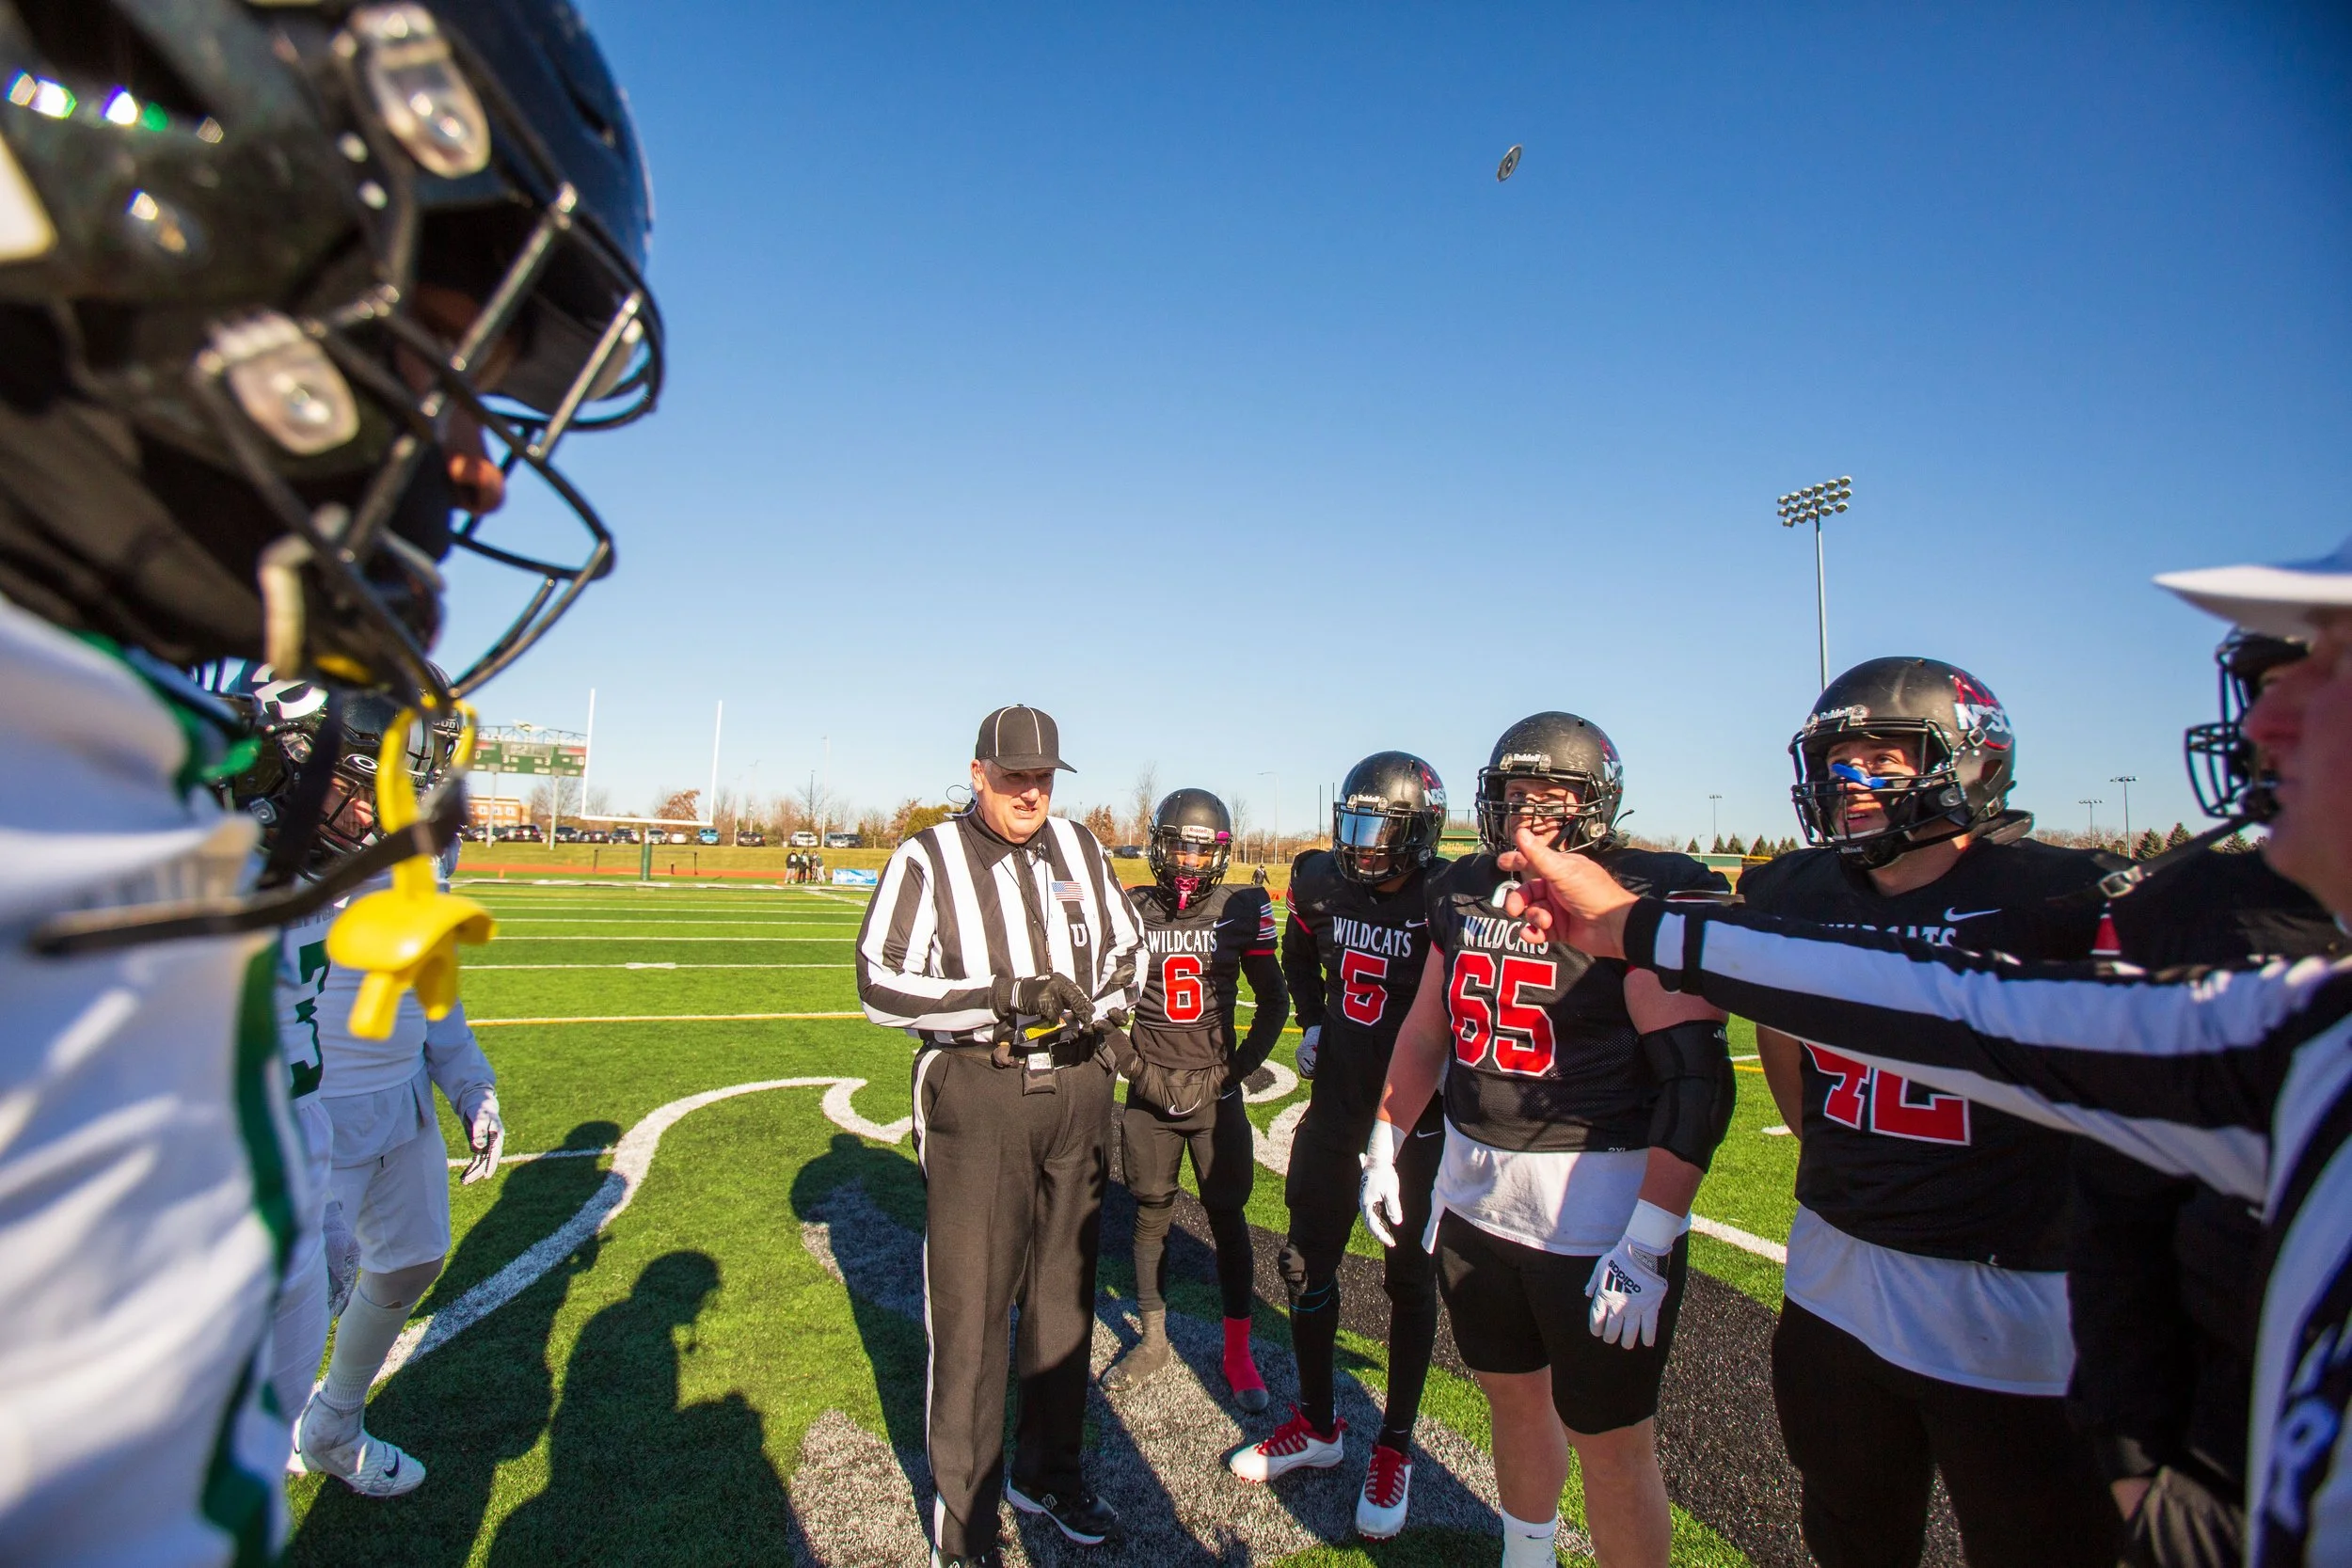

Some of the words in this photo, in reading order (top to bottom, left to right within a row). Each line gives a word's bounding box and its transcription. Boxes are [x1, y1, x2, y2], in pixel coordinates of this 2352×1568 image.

[1820, 707, 1851, 721] Riddell
[1513, 753, 1541, 762] Riddell
[1358, 794, 1380, 802] Riddell
[1070, 924, 1088, 947] U
[1148, 929, 1217, 953] WILDCATS
[1333, 915, 1412, 958] WILDCATS
[1162, 954, 1204, 1023] 6
[1340, 947, 1389, 1026] 5
[1448, 949, 1557, 1077] 65
[1608, 1259, 1642, 1293] adidas
